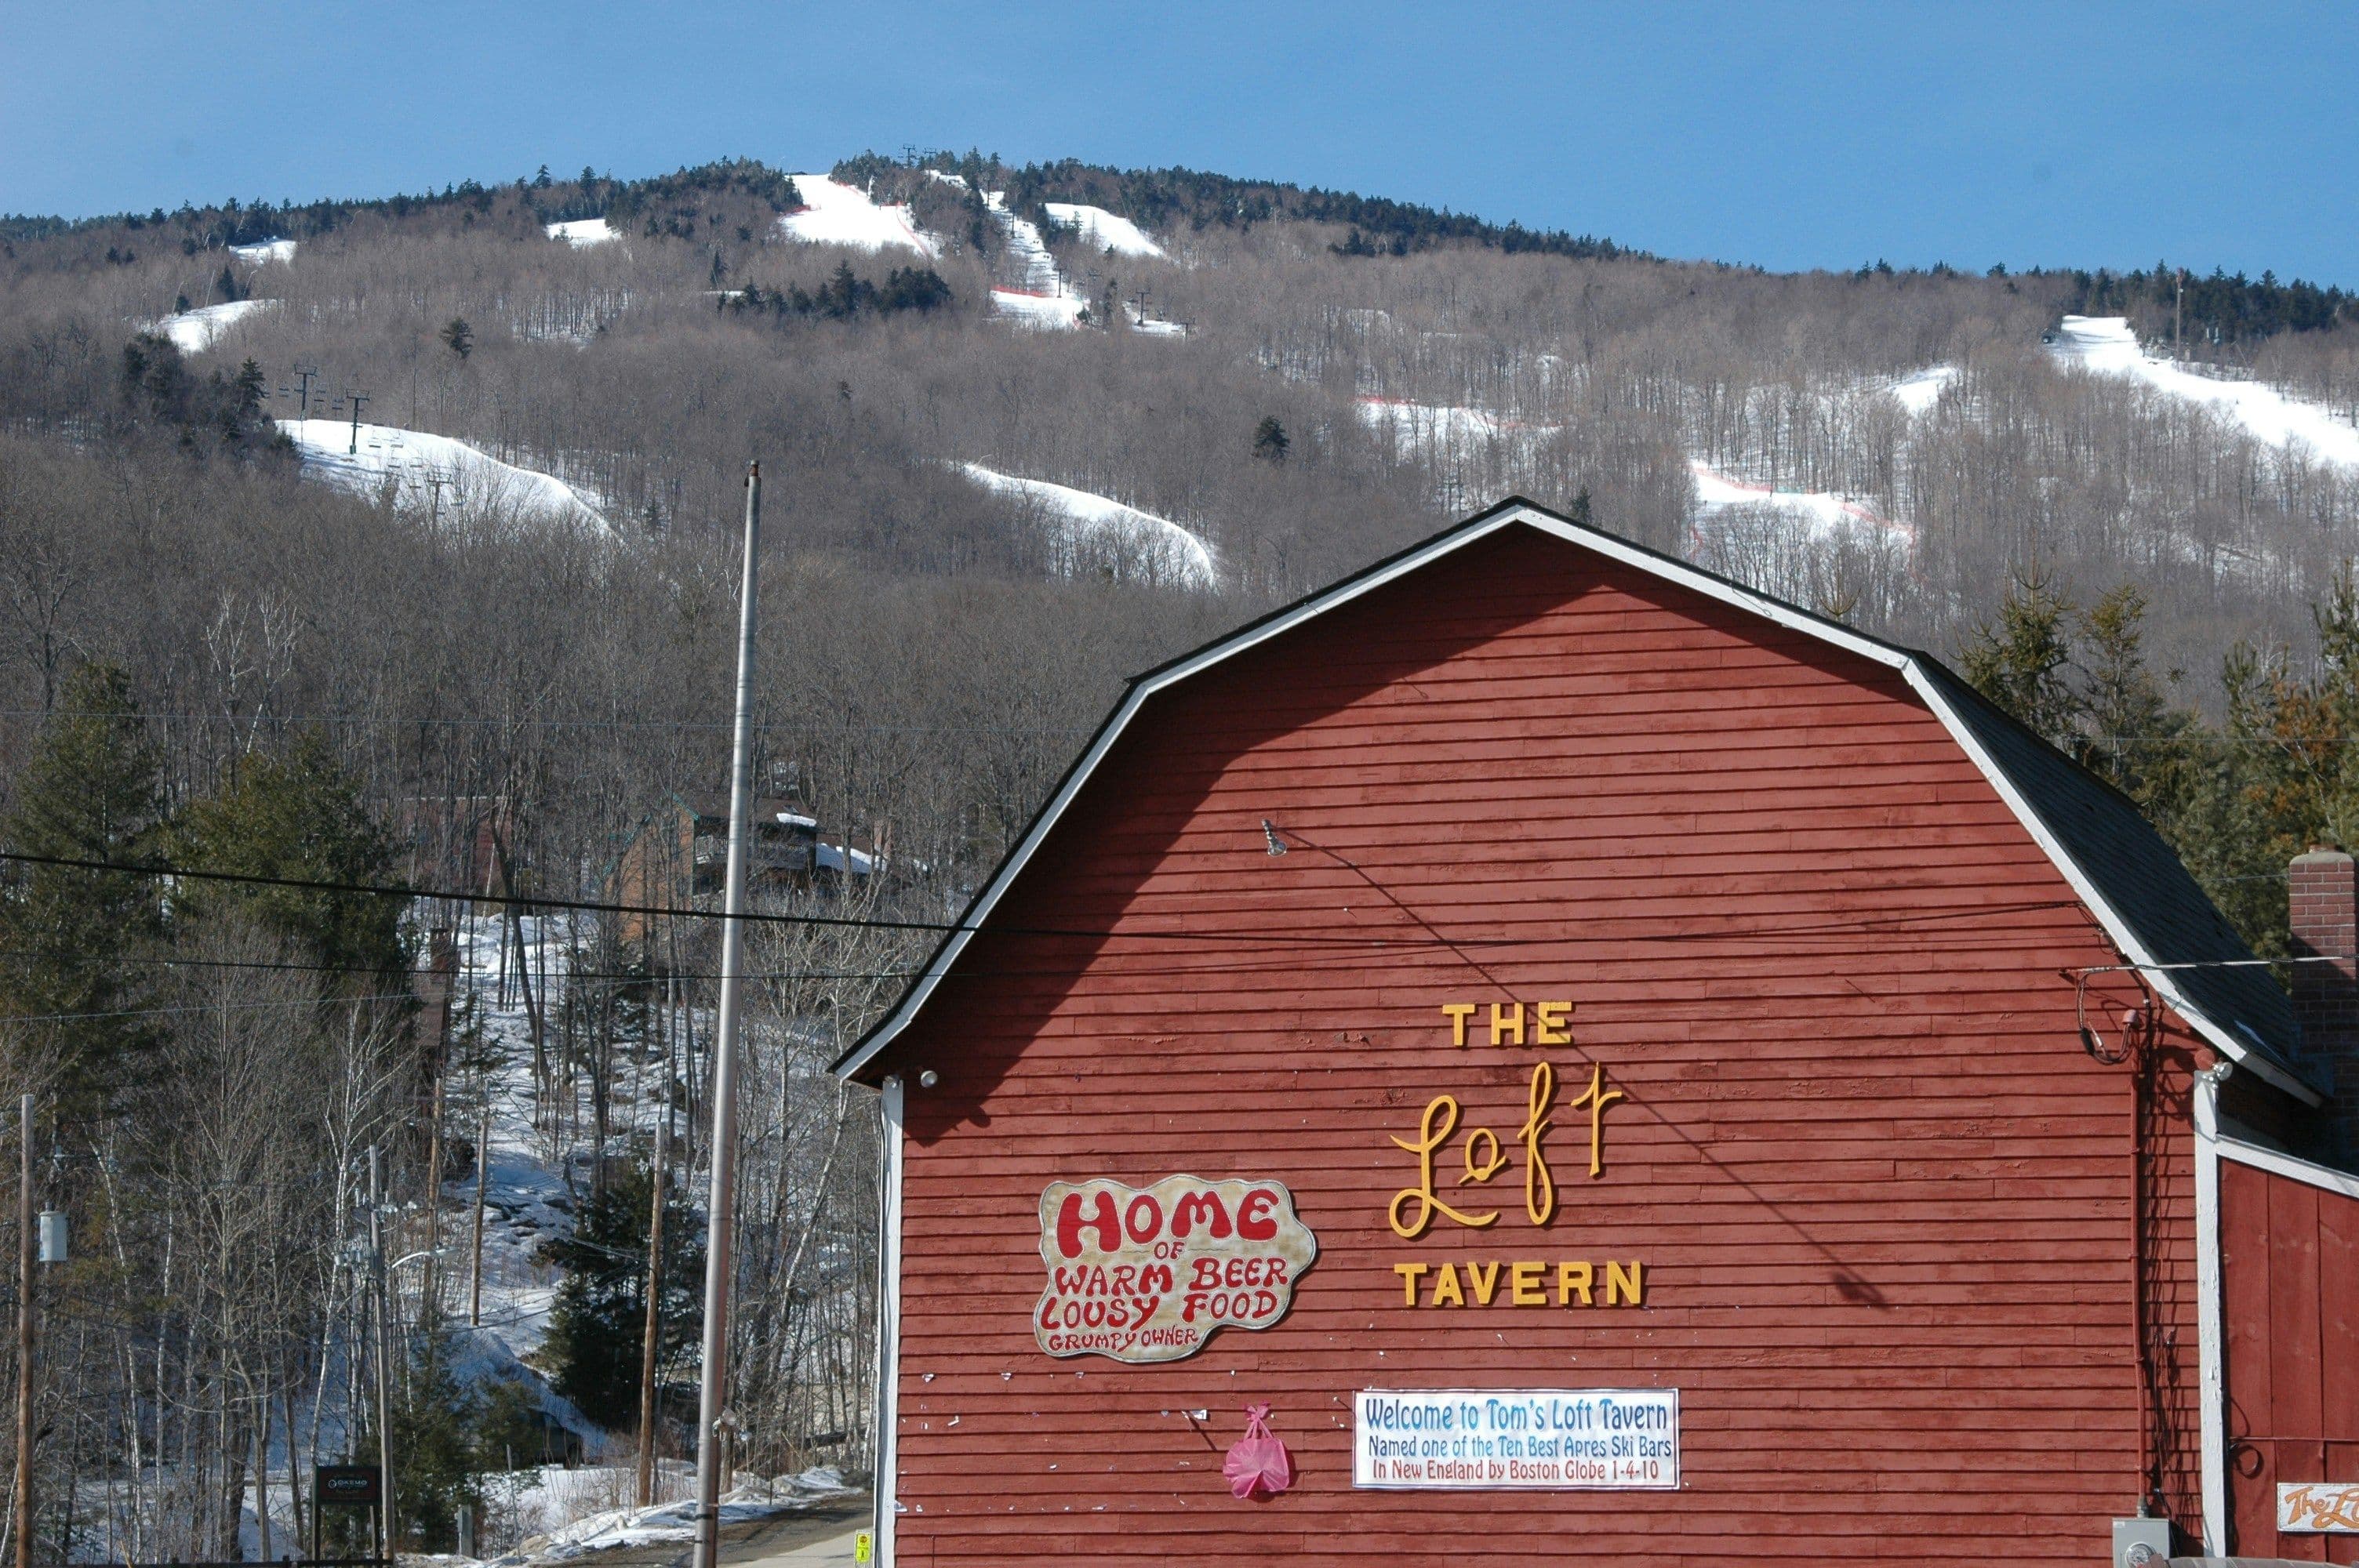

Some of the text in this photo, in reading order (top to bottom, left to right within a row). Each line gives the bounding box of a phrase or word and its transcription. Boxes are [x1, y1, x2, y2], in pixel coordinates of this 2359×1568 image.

[1442, 1001, 1572, 1046] THE
[1389, 1061, 1623, 1238] Loft
[1057, 1189, 1280, 1259] HOME
[1154, 1241, 1186, 1261] OF
[1054, 1257, 1289, 1297] WARM BEER
[1394, 1261, 1641, 1306] TAVERN
[1040, 1290, 1279, 1332] LOUSY FOOD
[1048, 1325, 1199, 1352] GRUMPY OWNER
[1366, 1398, 1667, 1430] Welcome to Tom's Loft Tavern
[1369, 1436, 1671, 1457] Named one of the Ten Best Apres Ski Bars
[1372, 1460, 1659, 1480] In New England by Boston Globe 1-4-10
[2284, 1486, 2330, 1524] The
